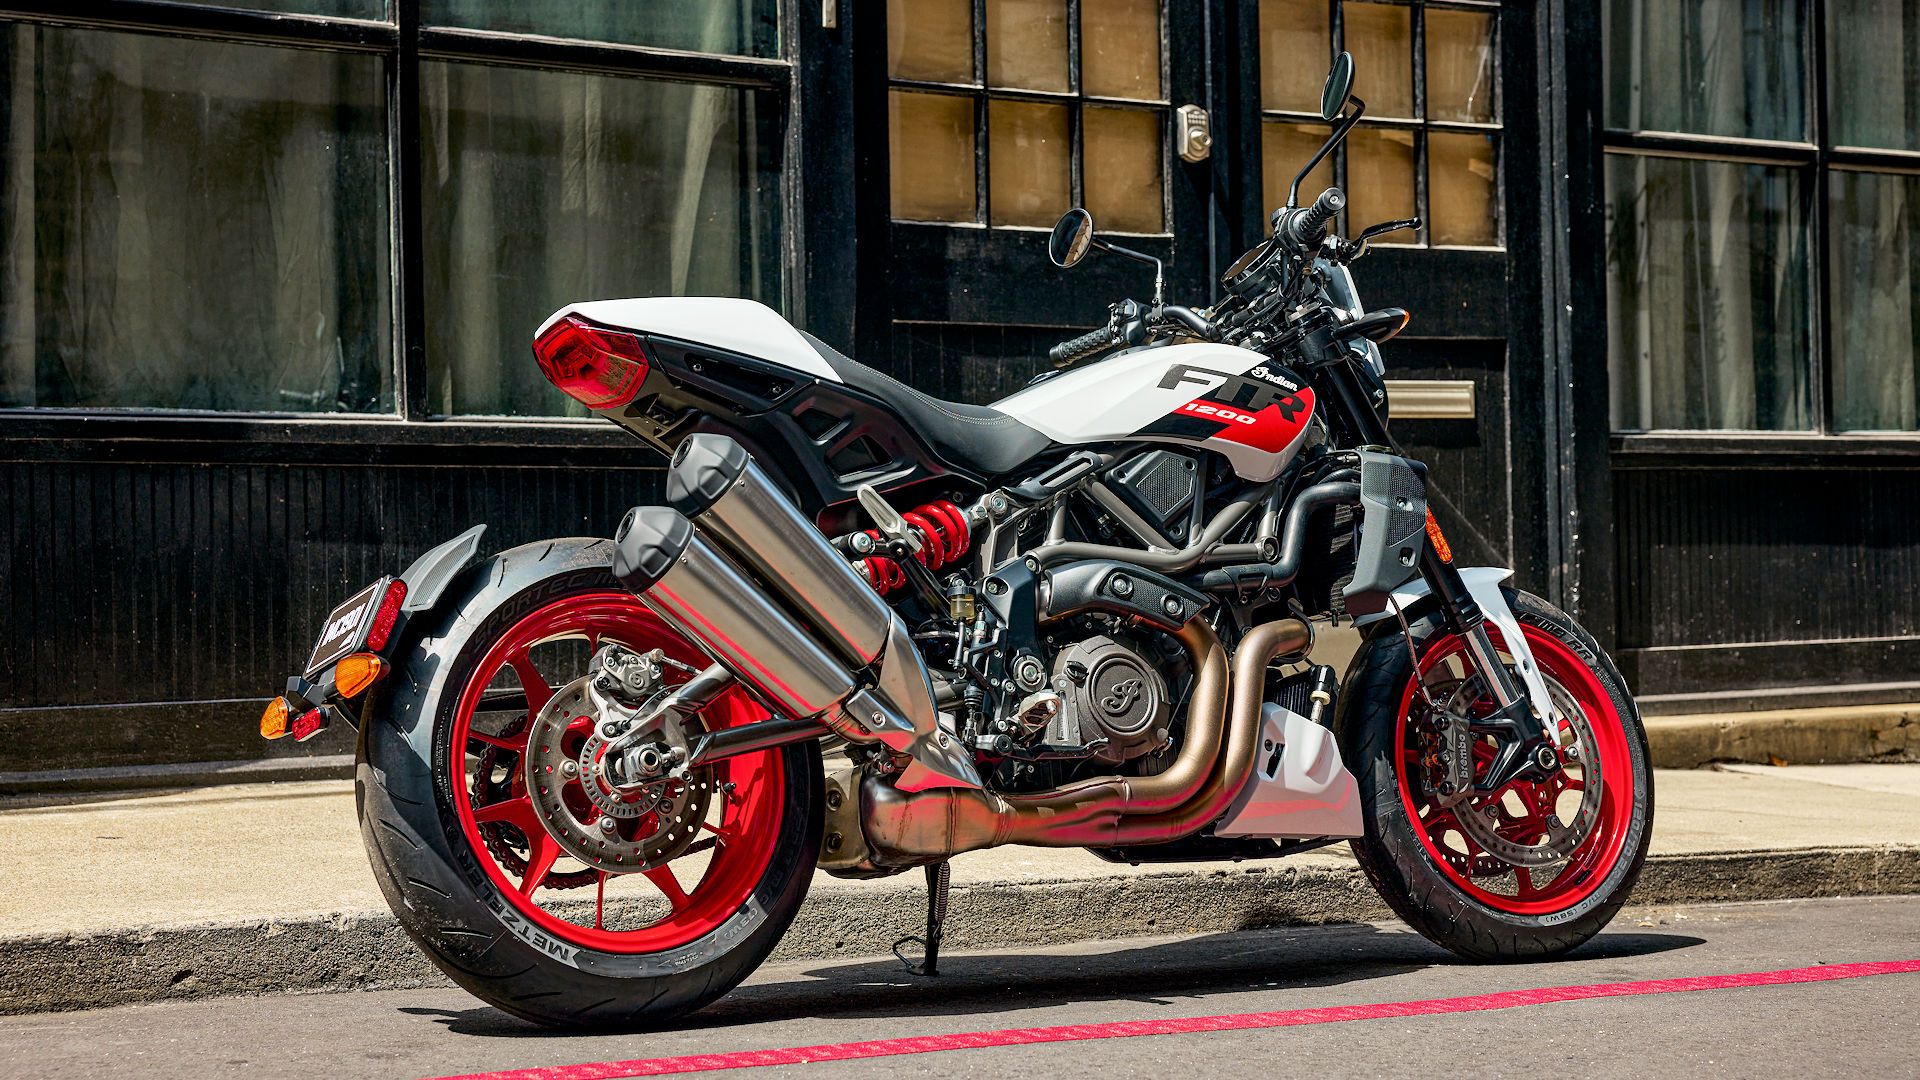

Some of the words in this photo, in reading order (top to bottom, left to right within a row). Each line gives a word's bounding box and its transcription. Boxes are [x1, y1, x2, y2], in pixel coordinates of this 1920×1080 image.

[1157, 364, 1305, 424] FTR
[1251, 366, 1298, 391] Indian
[1185, 403, 1256, 424] 1200
[473, 573, 588, 651] SPORTEC
[1566, 640, 1593, 661] RR
[1458, 734, 1469, 779] brembo
[459, 850, 570, 960] METZELER
[723, 907, 758, 938] (73W)
